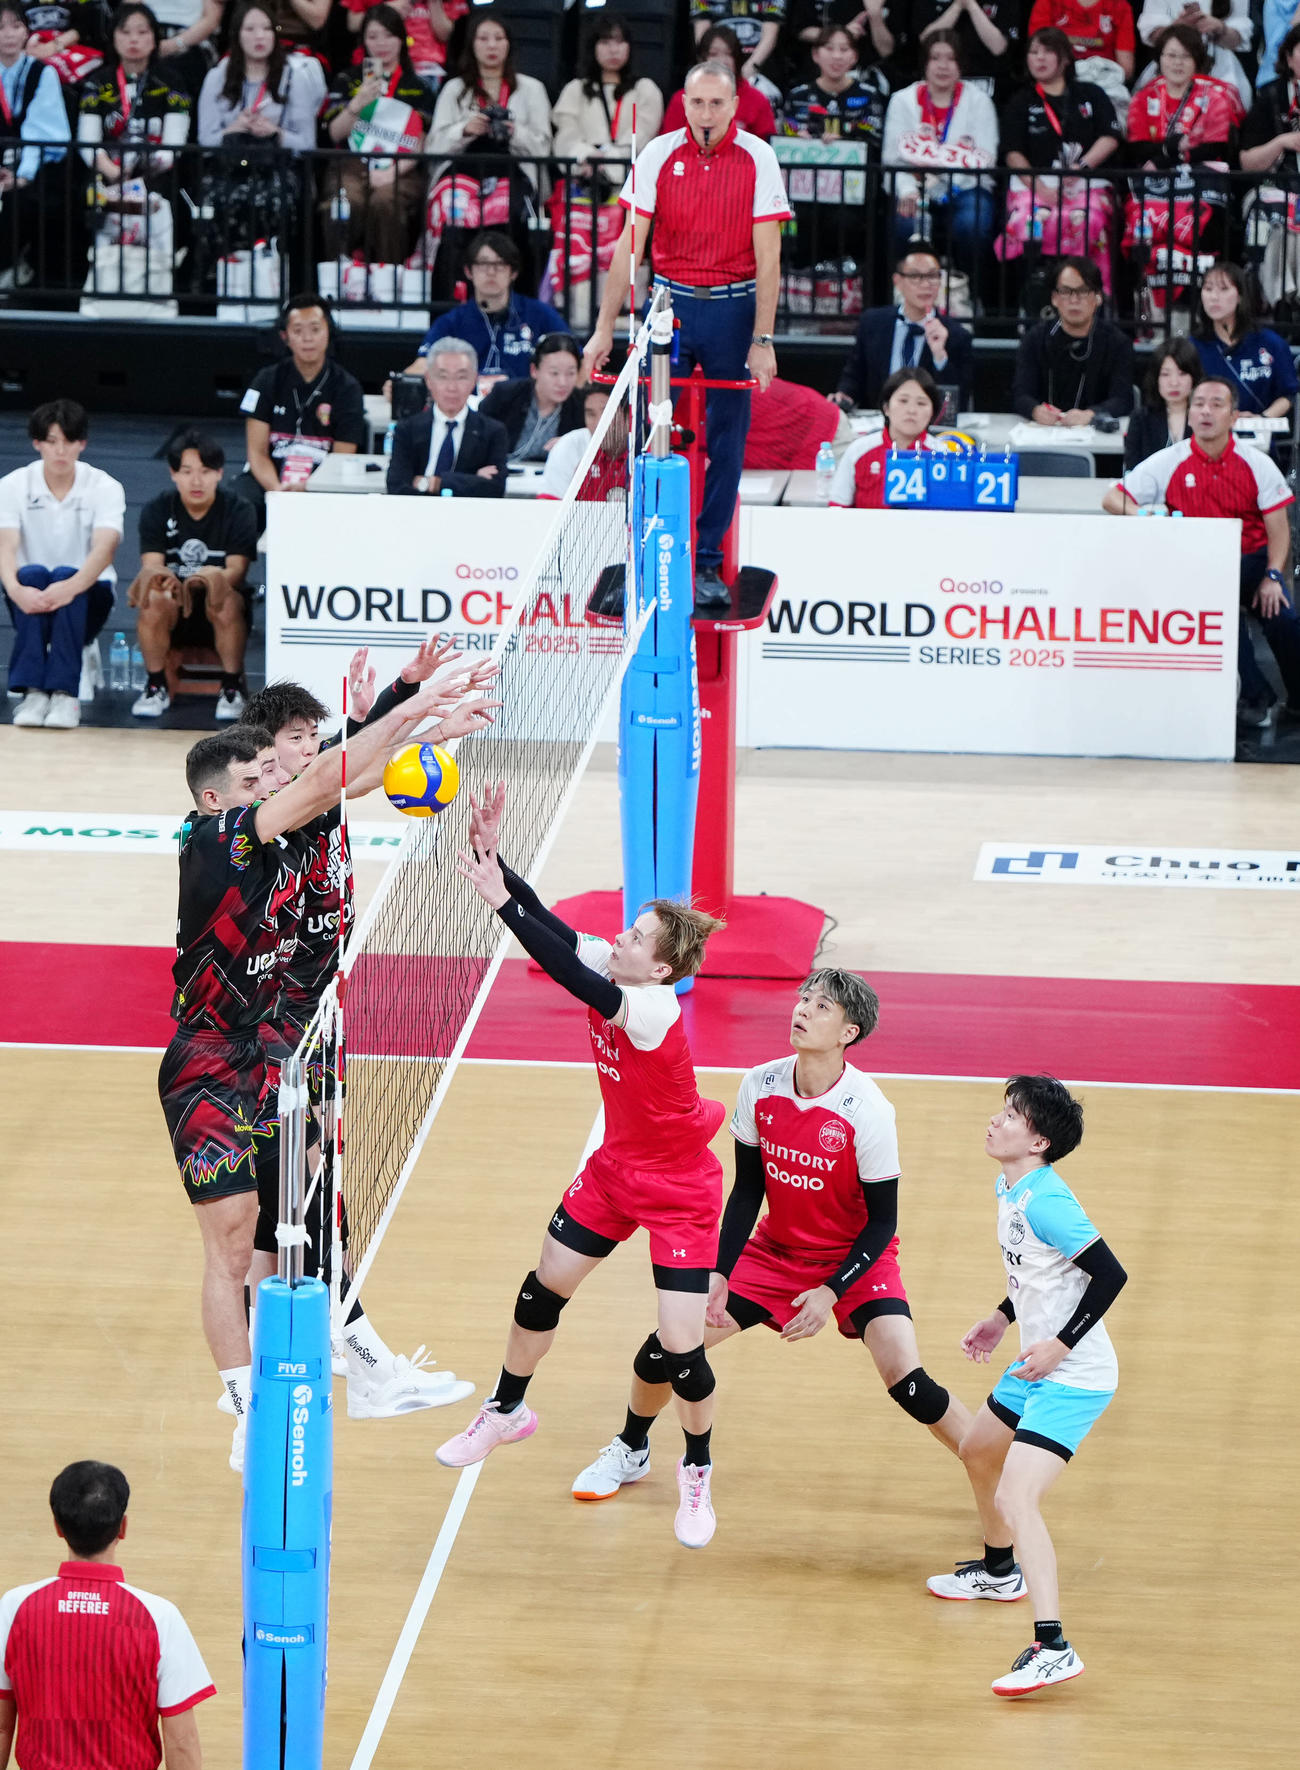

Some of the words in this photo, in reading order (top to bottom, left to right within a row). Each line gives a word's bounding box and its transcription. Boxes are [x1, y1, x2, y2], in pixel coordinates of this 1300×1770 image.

[887, 467, 927, 502] 24
[931, 462, 947, 481] 0
[957, 464, 967, 482] 1
[976, 471, 1010, 504] 21
[455, 563, 519, 581] Qoo10
[658, 550, 673, 612] Senoh
[939, 577, 1003, 594] Qoo10
[281, 585, 453, 624] WORLD
[765, 599, 936, 638] WORLD
[943, 604, 1224, 646] CHALLENGE
[525, 634, 580, 654] 2025
[919, 646, 1001, 666] SERIES
[1008, 648, 1065, 668] 2025
[23, 826, 160, 840] MOS
[1104, 855, 1261, 872] Chuo
[760, 1136, 839, 1172] SUNTORY
[766, 1161, 825, 1191] Qoo10
[345, 1334, 378, 1368] MoveSport
[226, 1379, 245, 1417] MoveSport
[292, 1407, 309, 1487] Senoh
[58, 1599, 110, 1616] REFEREE
[67, 1591, 102, 1602] OFFICIAL
[265, 1632, 306, 1644] Senoh
